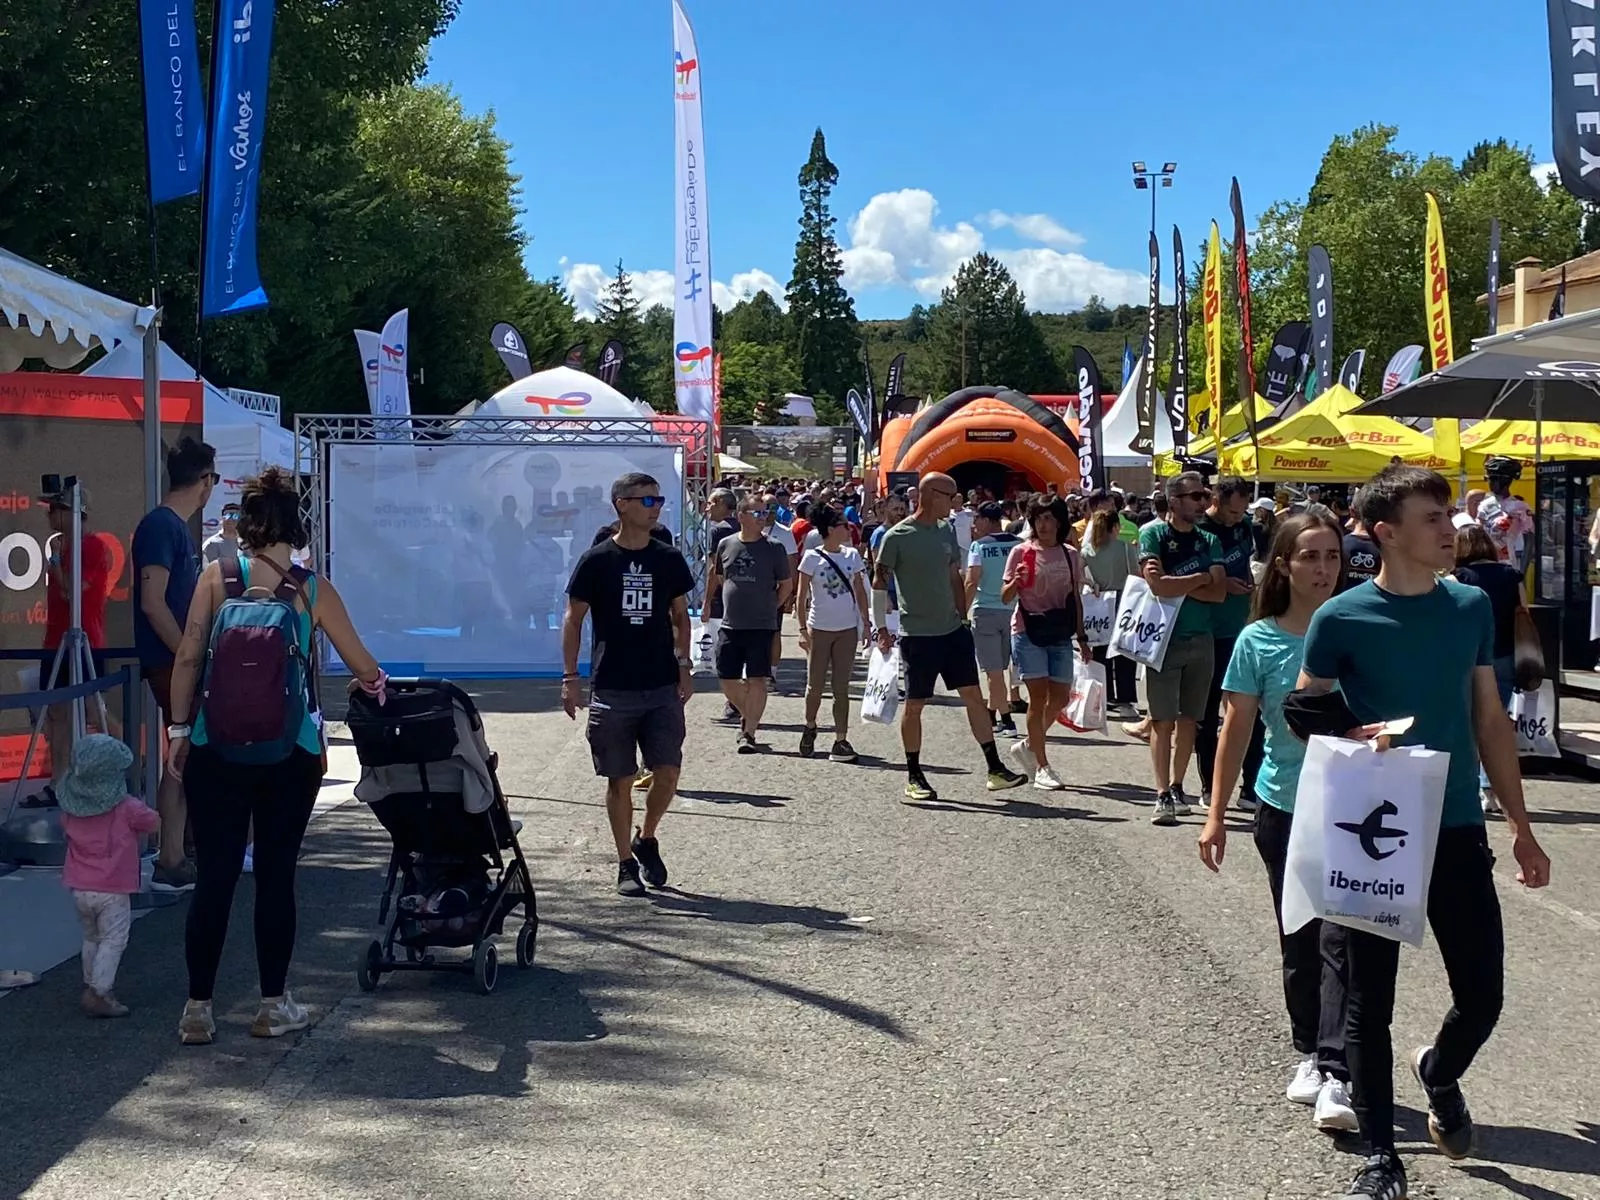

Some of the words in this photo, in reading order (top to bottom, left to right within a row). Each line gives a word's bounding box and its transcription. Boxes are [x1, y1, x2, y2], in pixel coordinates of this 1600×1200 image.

[167, 3, 180, 47] DEL
[170, 56, 184, 137] BANCO
[177, 144, 187, 171] EL
[1308, 431, 1404, 447] PowerBar
[1274, 455, 1331, 469] PowerBar
[982, 546, 999, 557] THE
[622, 590, 652, 611] QH
[1330, 870, 1405, 901] ibercaja
